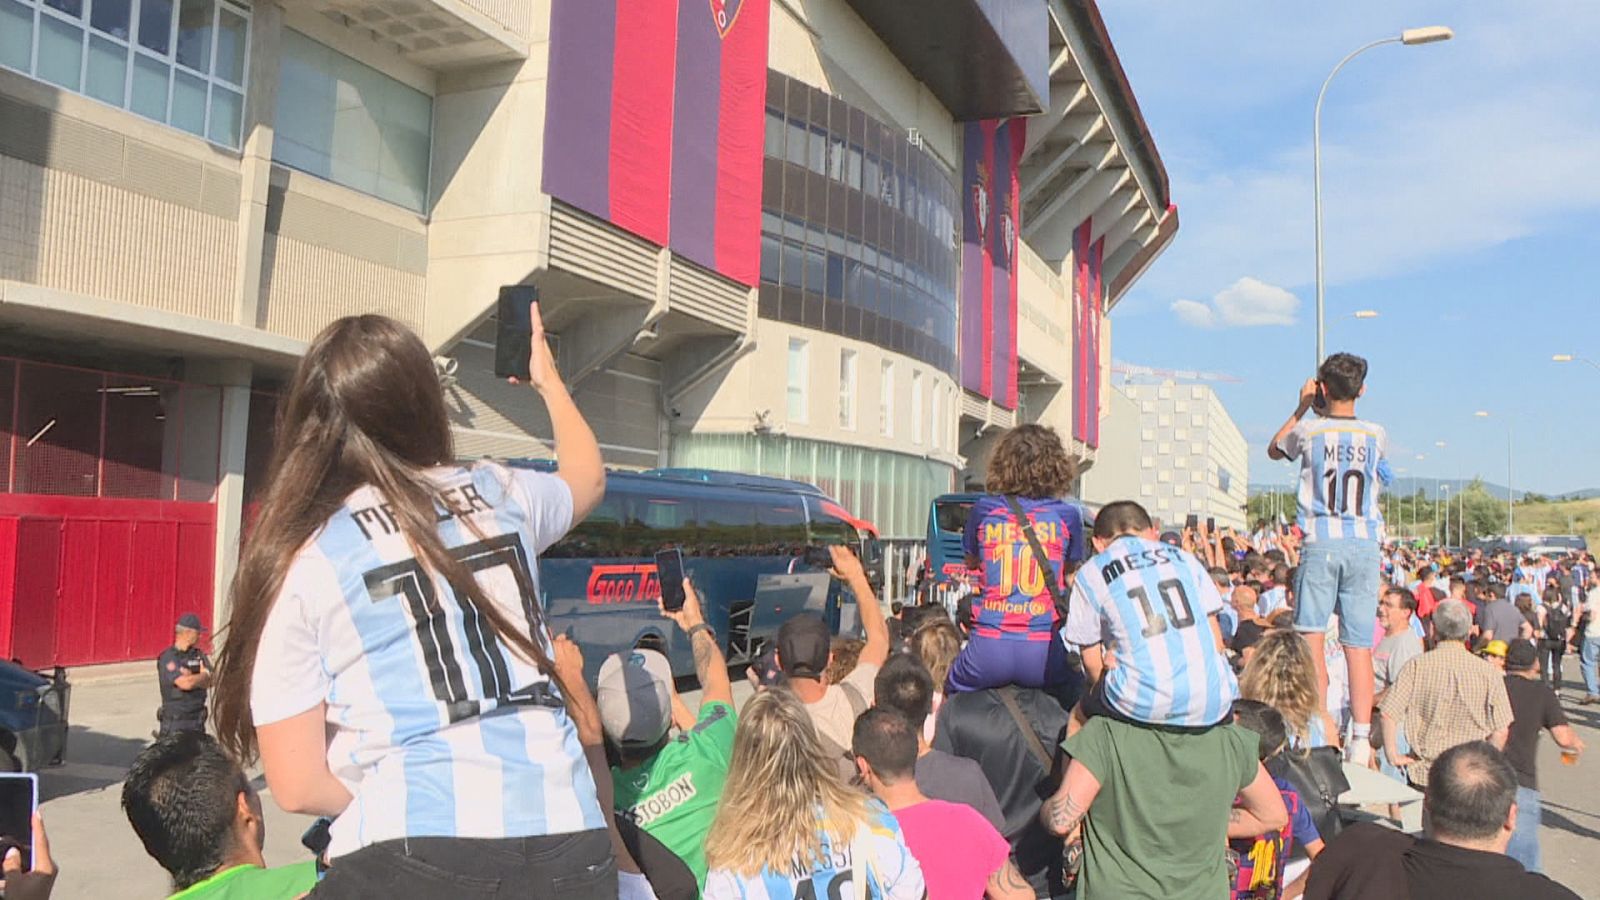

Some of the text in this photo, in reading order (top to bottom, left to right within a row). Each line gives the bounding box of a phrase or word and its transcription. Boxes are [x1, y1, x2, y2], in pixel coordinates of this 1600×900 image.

[1323, 445, 1371, 464] MESSI
[1323, 468, 1364, 517] 10
[992, 543, 1048, 597] 10
[361, 532, 562, 724] 10
[984, 599, 1031, 614] unicef
[1127, 577, 1196, 638] 10
[791, 842, 853, 880] MSSI
